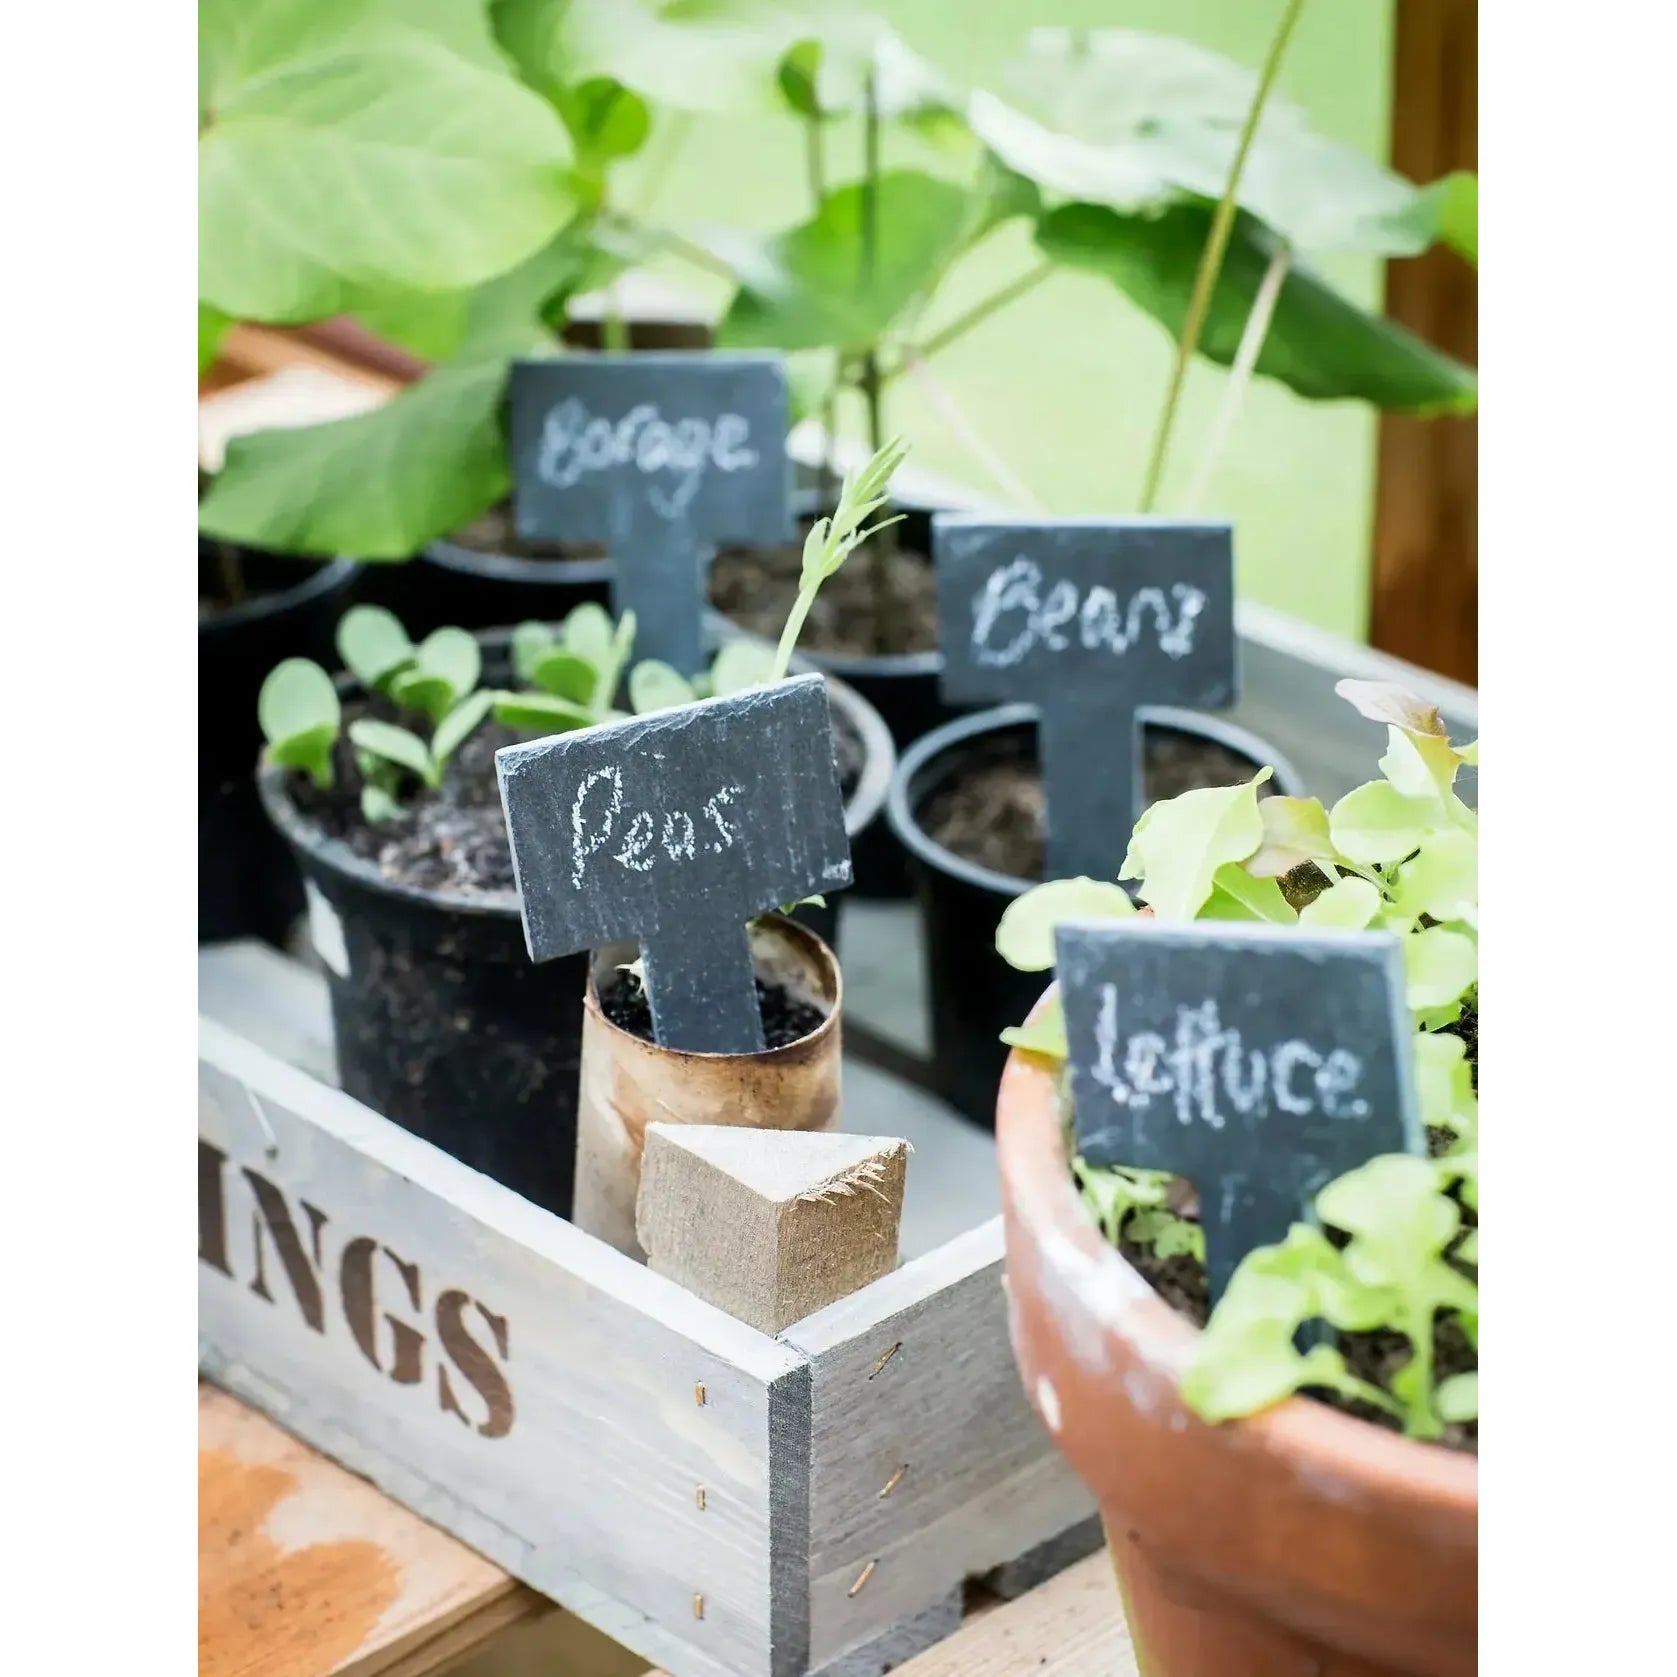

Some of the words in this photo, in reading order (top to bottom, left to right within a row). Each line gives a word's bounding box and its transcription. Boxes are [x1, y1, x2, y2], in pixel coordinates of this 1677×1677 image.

[538, 397, 760, 519] Borage
[571, 765, 746, 890] Peas
[198, 1138, 516, 1439] INGS
